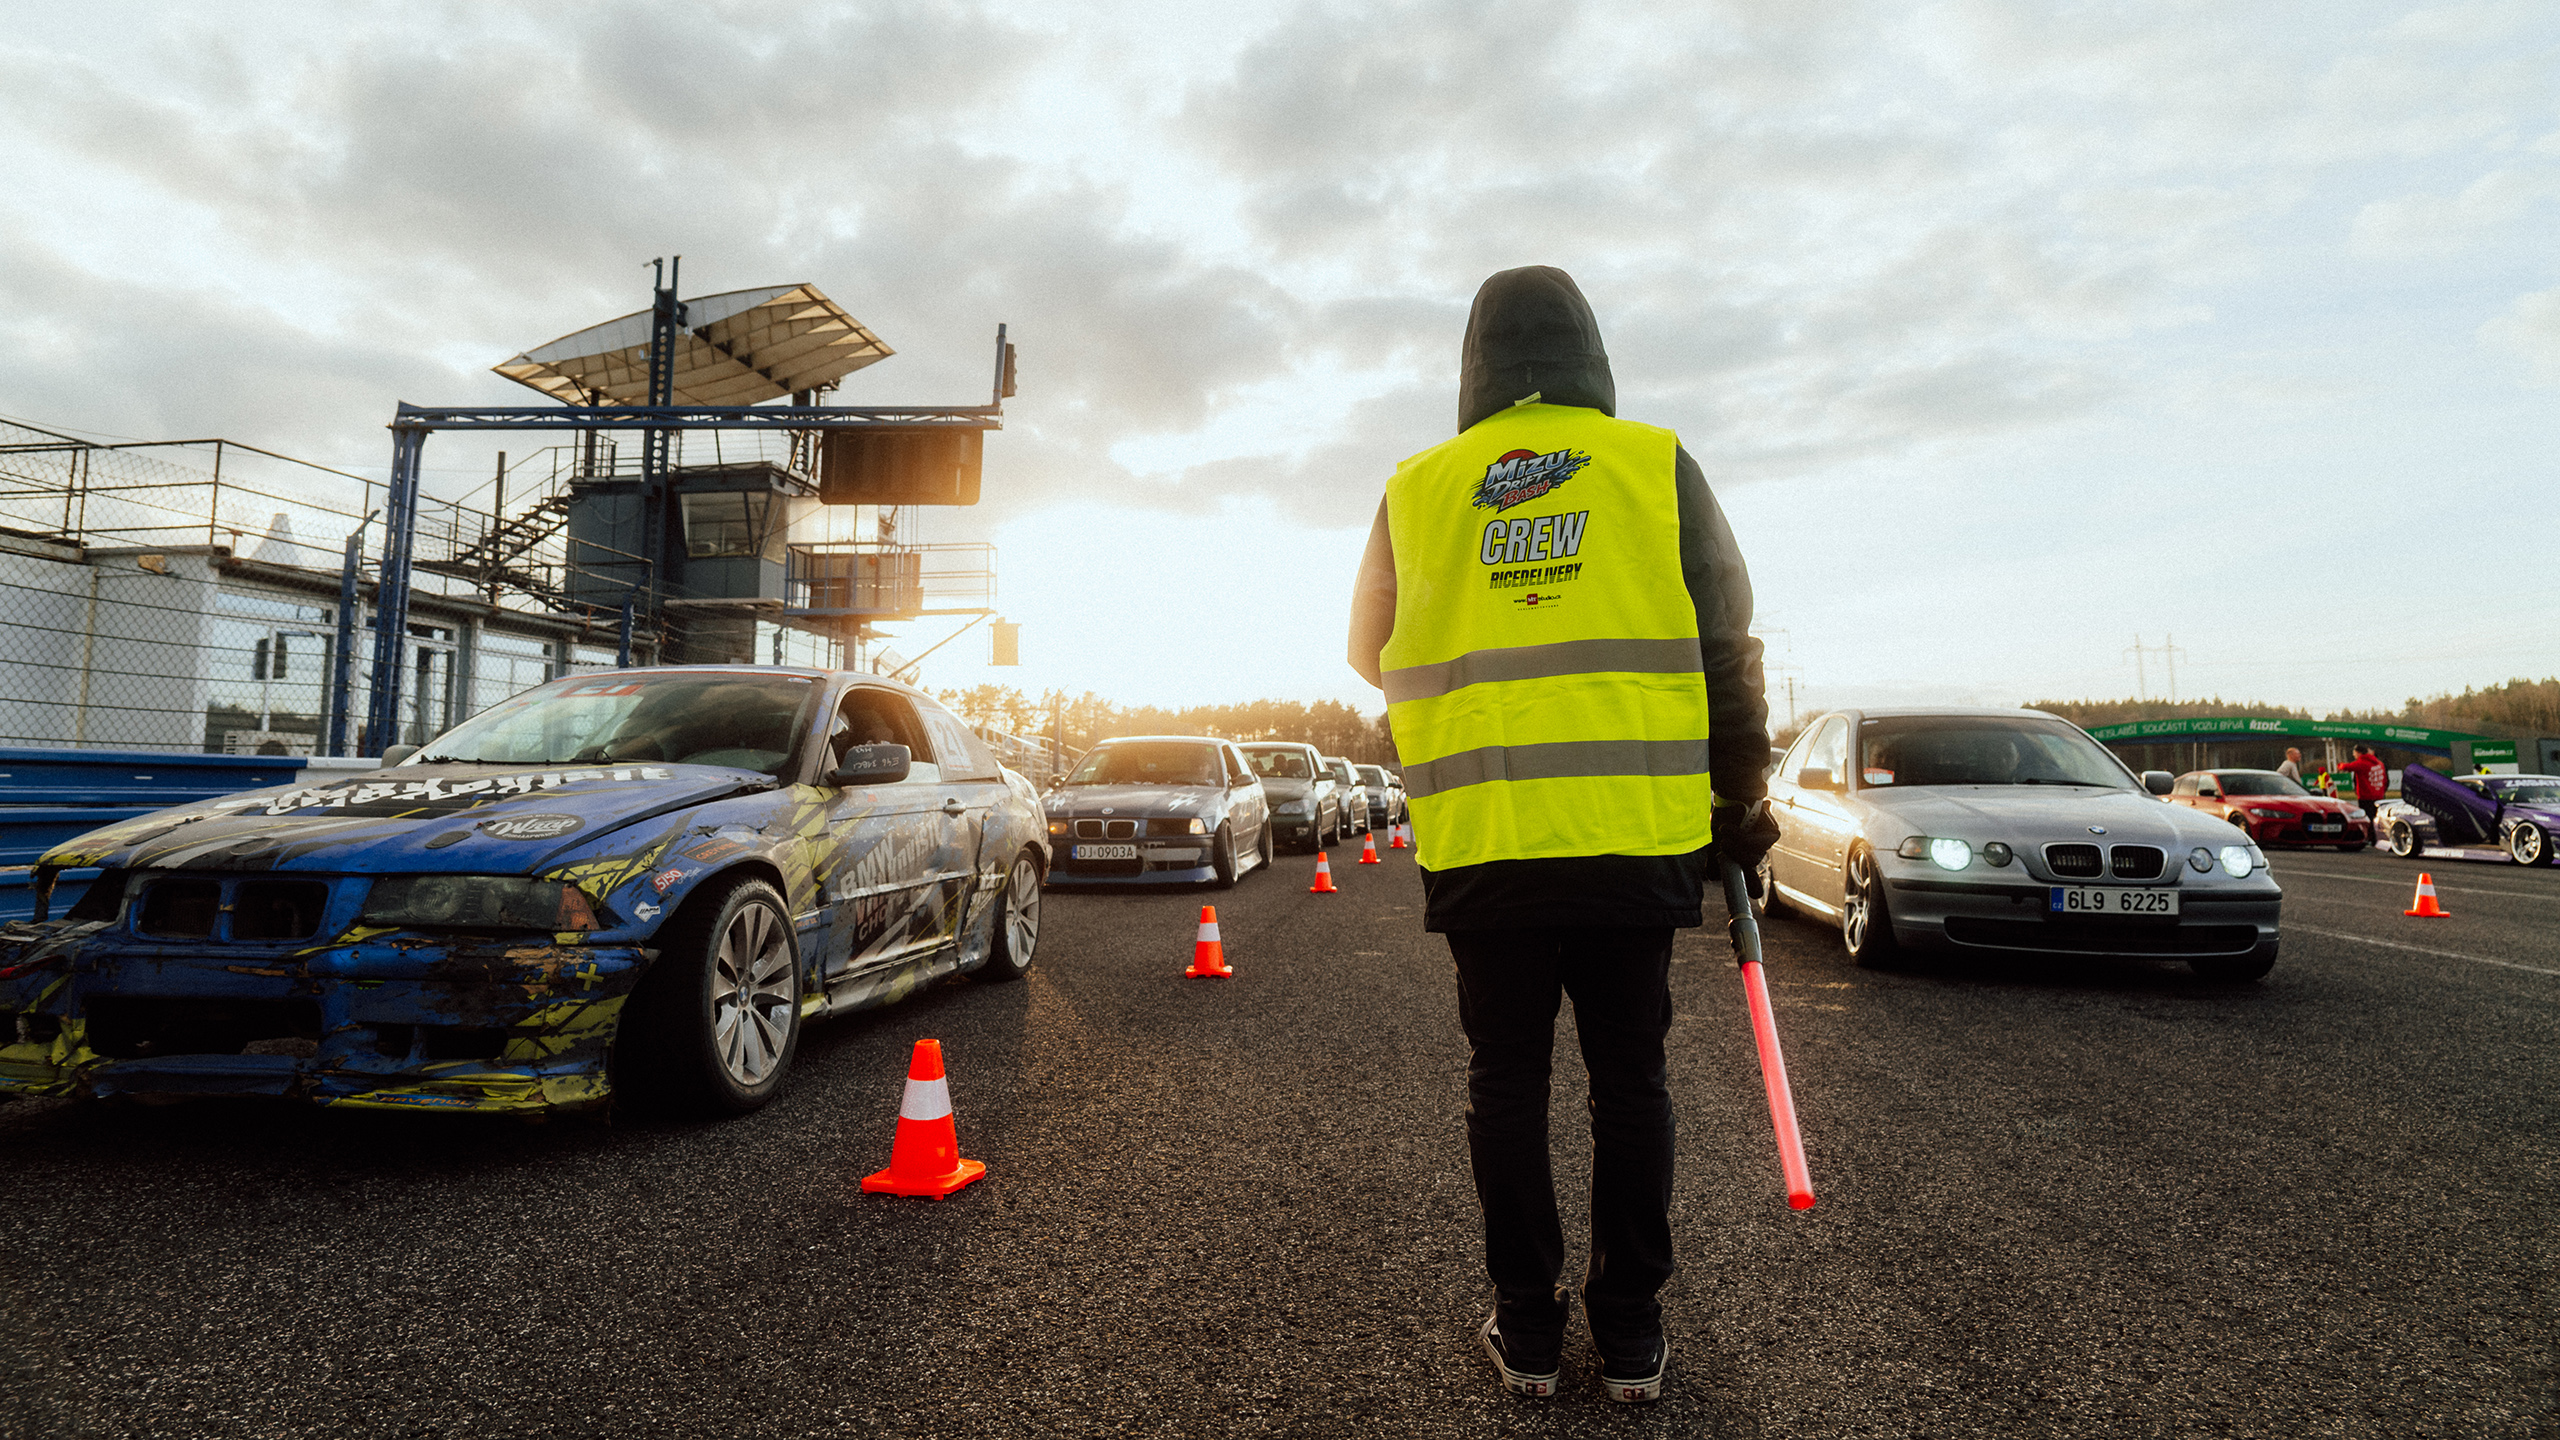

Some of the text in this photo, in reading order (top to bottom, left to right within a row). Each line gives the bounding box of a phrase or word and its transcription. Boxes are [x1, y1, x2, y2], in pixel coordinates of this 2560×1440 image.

[1500, 479, 1552, 511] BASH
[1480, 510, 1590, 566] CREW
[1489, 562, 1583, 590] RICEDELIVERY
[2142, 720, 2187, 734] SOUČÁSTÍ
[2191, 722, 2219, 732] VOZU
[2219, 719, 2244, 731] BÝVÁ
[840, 832, 895, 900] BMW
[1079, 846, 1134, 858] DJ 0903A
[2067, 890, 2170, 912] 6L9 6225
